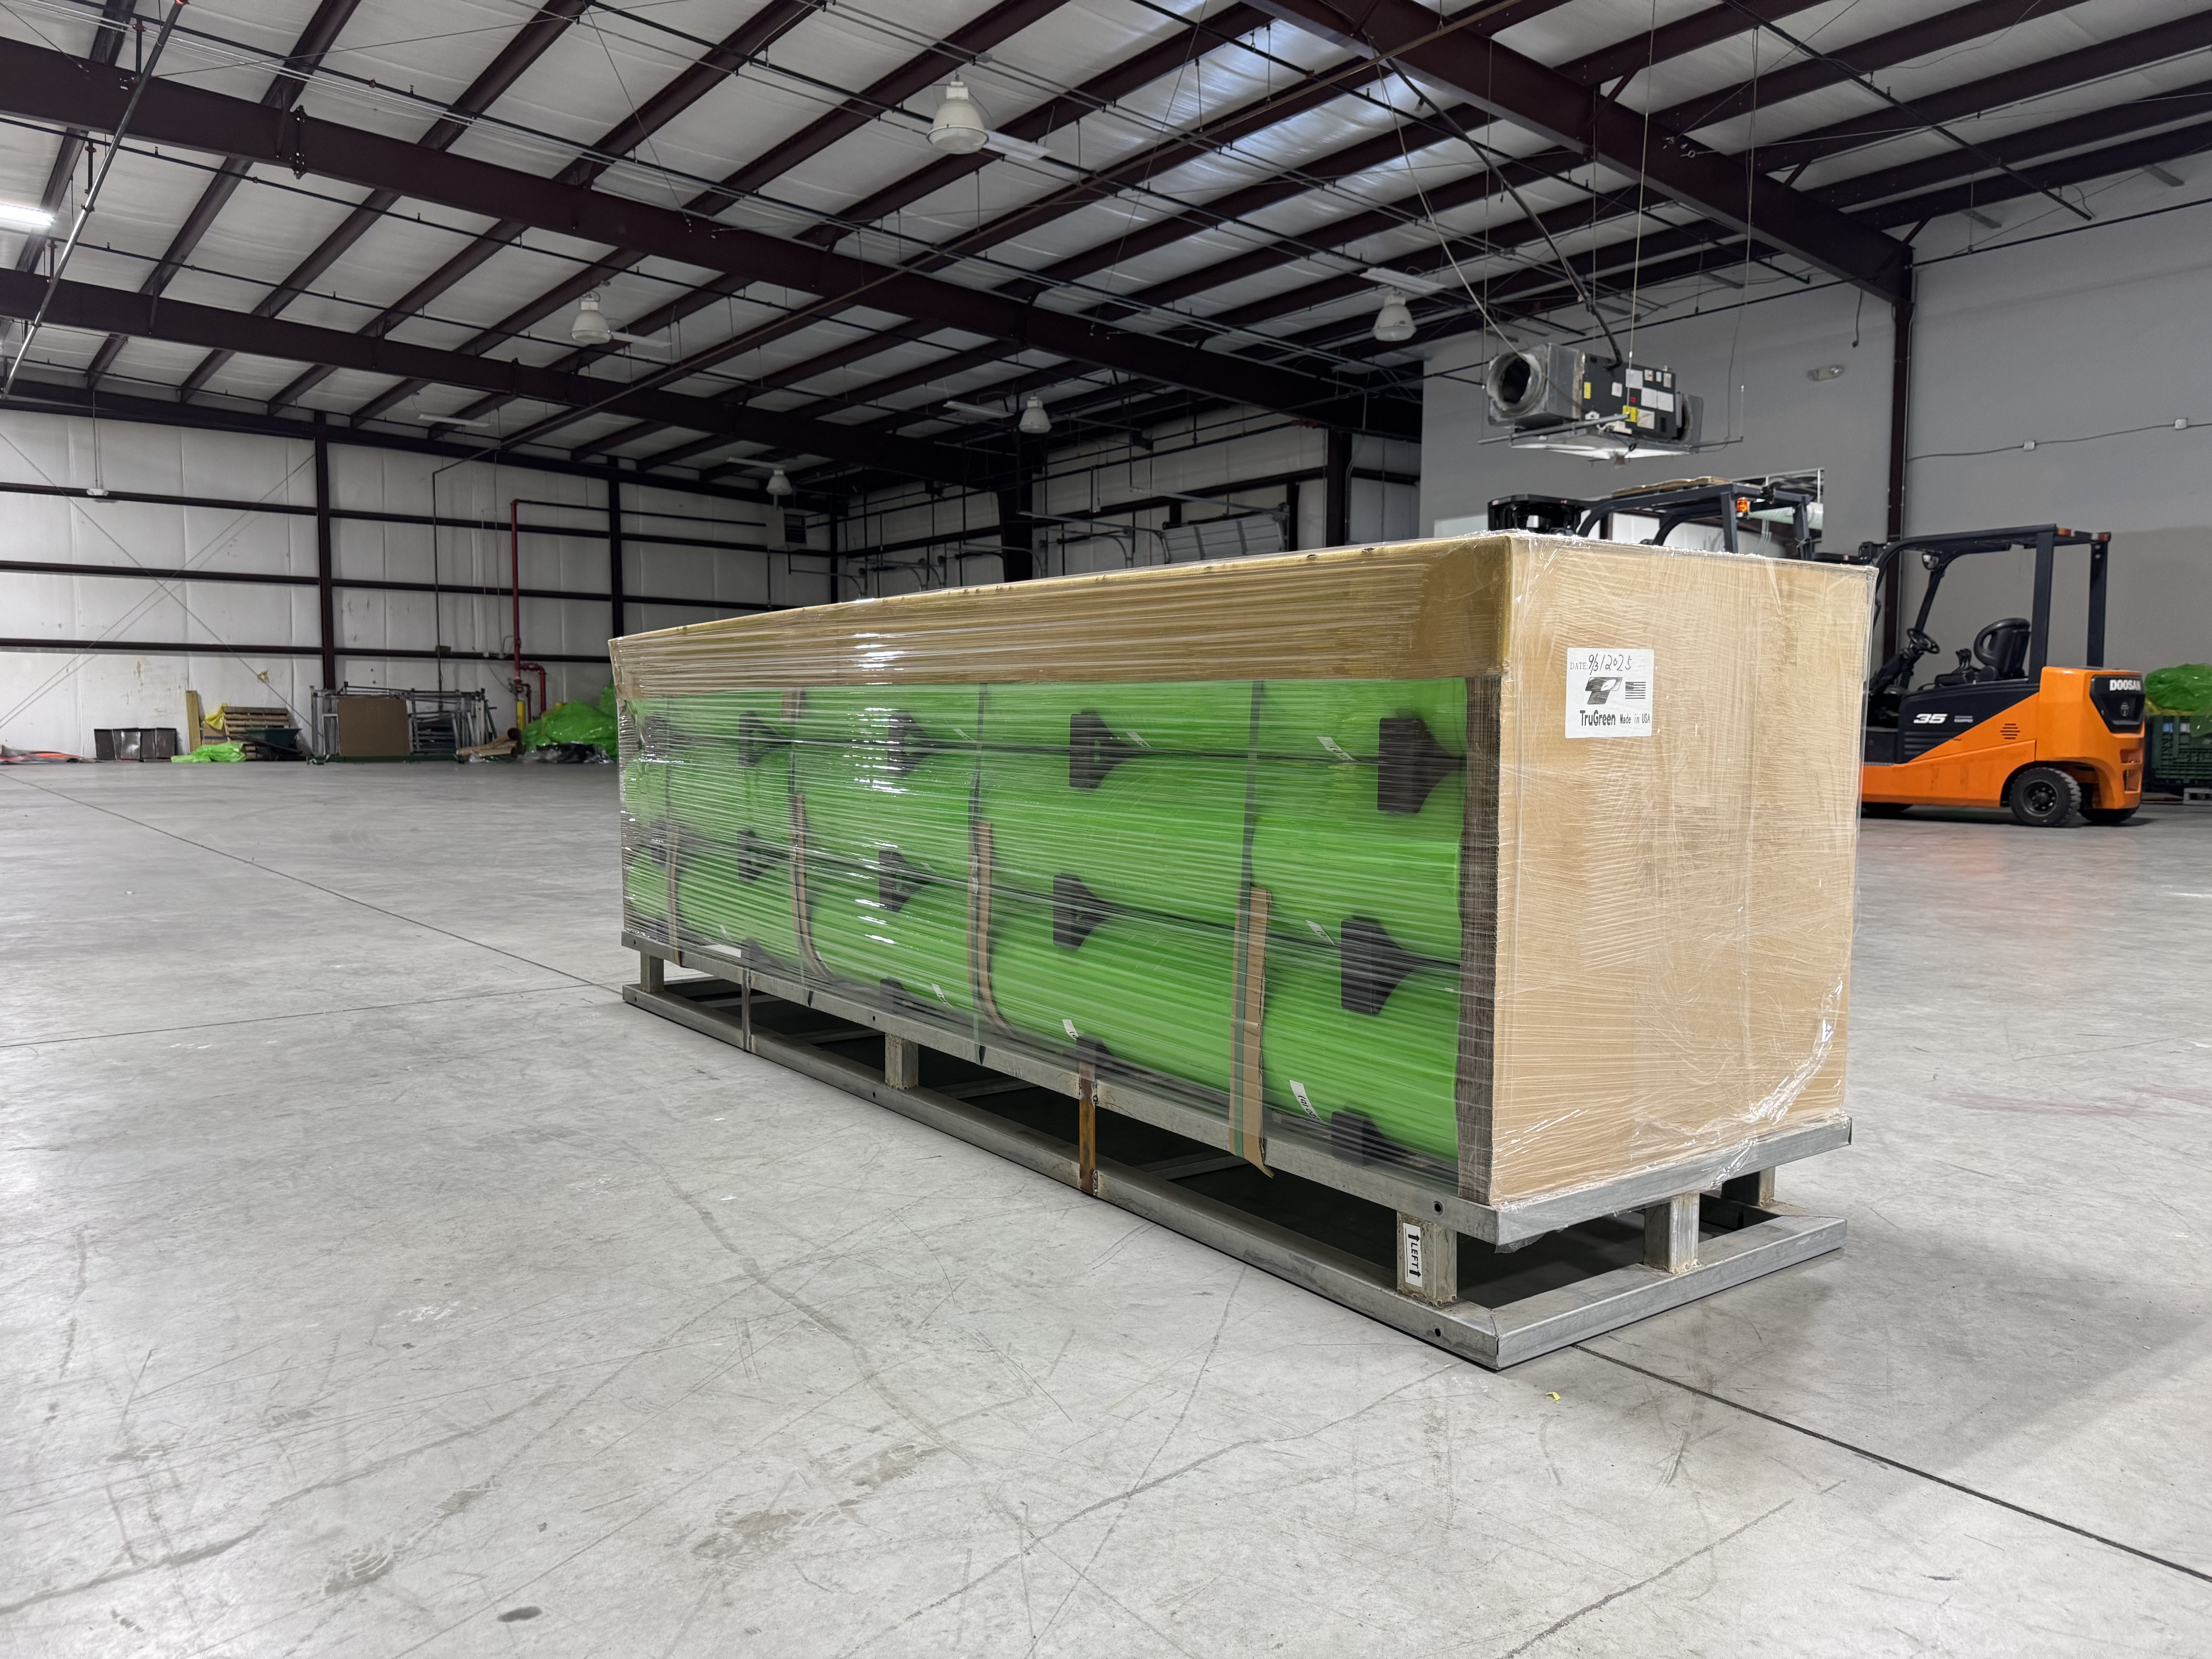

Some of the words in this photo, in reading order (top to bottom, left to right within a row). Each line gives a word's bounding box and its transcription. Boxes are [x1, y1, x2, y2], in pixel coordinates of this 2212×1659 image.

[2109, 679, 2141, 691] DOOSAN
[1580, 709, 1616, 726] TruGreen
[1620, 713, 1631, 724] Made
[1634, 713, 1640, 724] in
[1642, 713, 1650, 723] USA
[1913, 713, 1948, 724] 35
